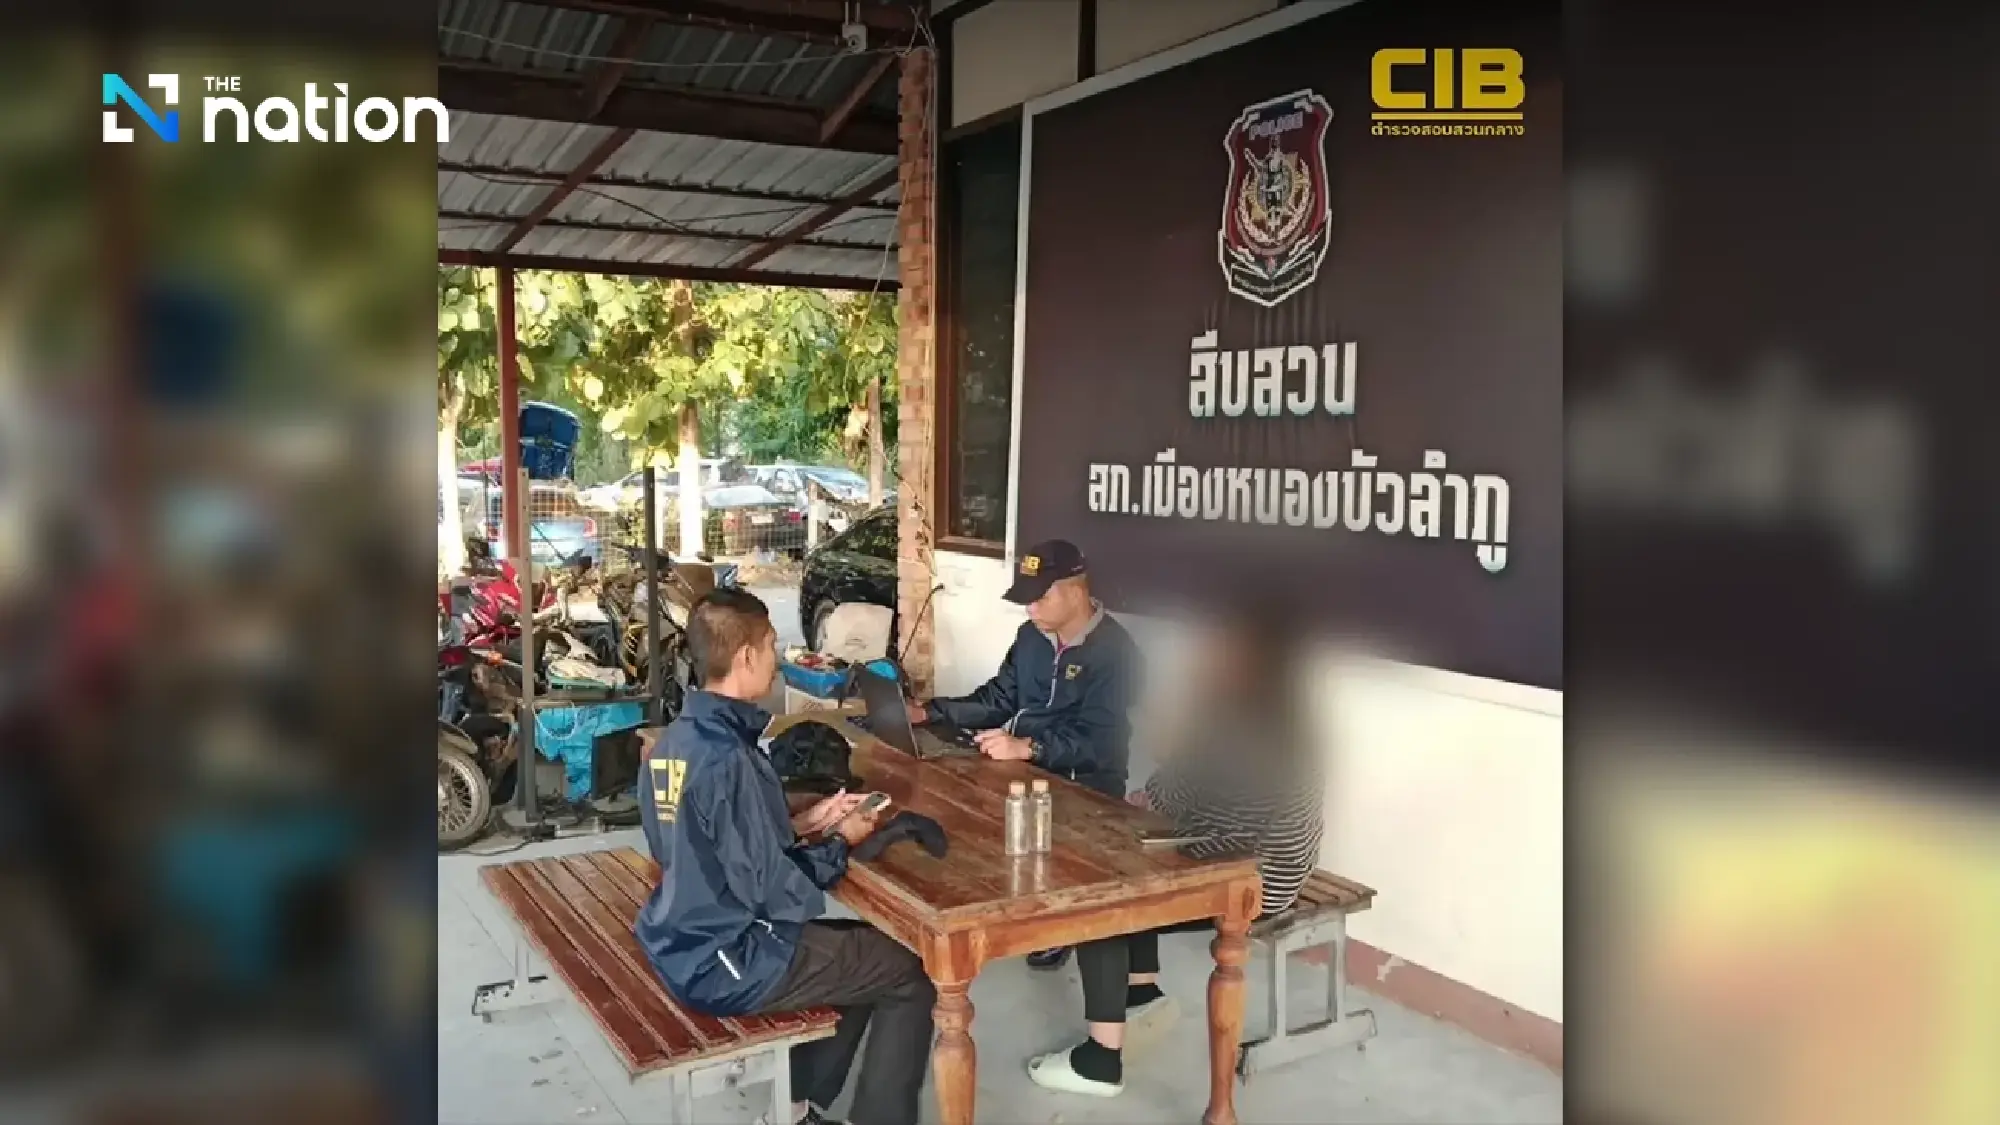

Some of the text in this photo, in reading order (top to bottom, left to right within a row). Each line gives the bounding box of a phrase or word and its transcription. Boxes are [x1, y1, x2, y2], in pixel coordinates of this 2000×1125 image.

[1189, 329, 1358, 418] สืบสวน
[1088, 447, 1510, 573] สภ.เมืองหนองบัวลำภู
[649, 758, 687, 806] CIB
